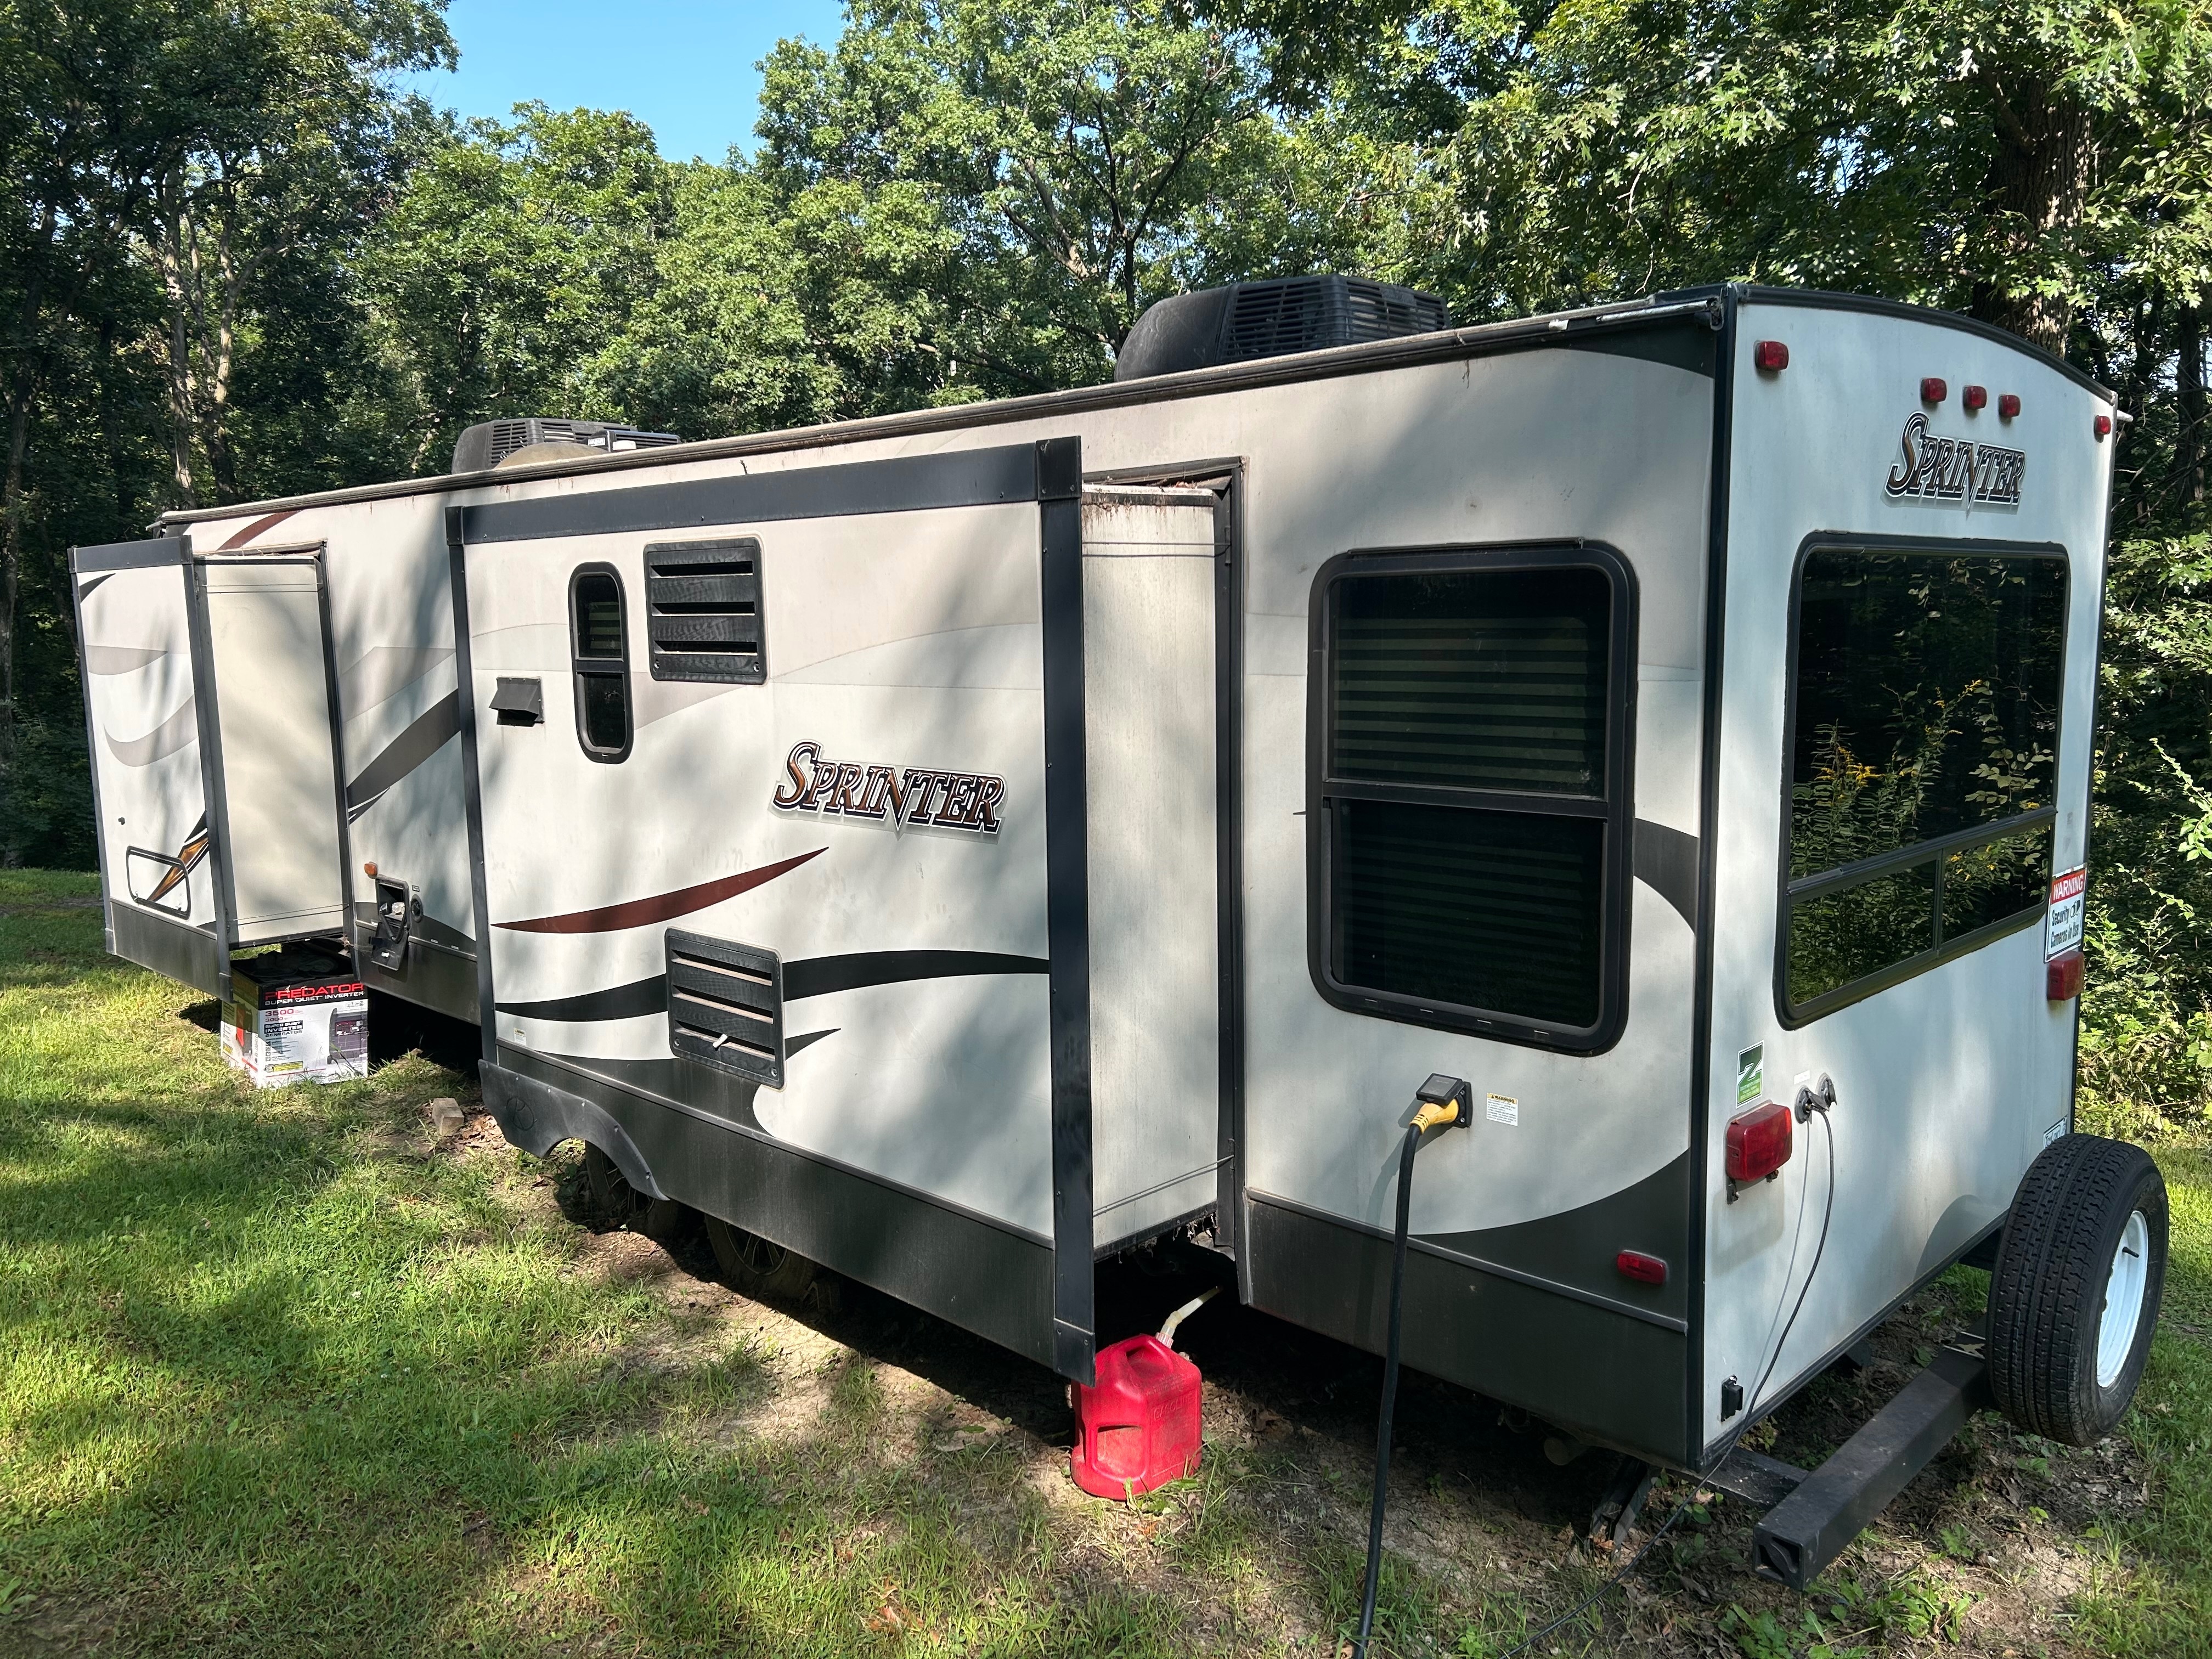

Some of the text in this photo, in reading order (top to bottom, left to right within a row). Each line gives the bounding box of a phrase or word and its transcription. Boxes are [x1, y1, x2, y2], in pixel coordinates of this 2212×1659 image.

[1884, 411, 2026, 510] SPRINTER
[772, 739, 1007, 833] SPRINTER
[2053, 874, 2084, 901] WARNING
[2052, 906, 2069, 927] Security
[2051, 929, 2068, 948] Cameras
[264, 983, 364, 1000] PREDATOR
[325, 991, 365, 1000] INVERTER
[265, 1008, 294, 1017] 3500
[265, 1025, 302, 1033] INVERTER
